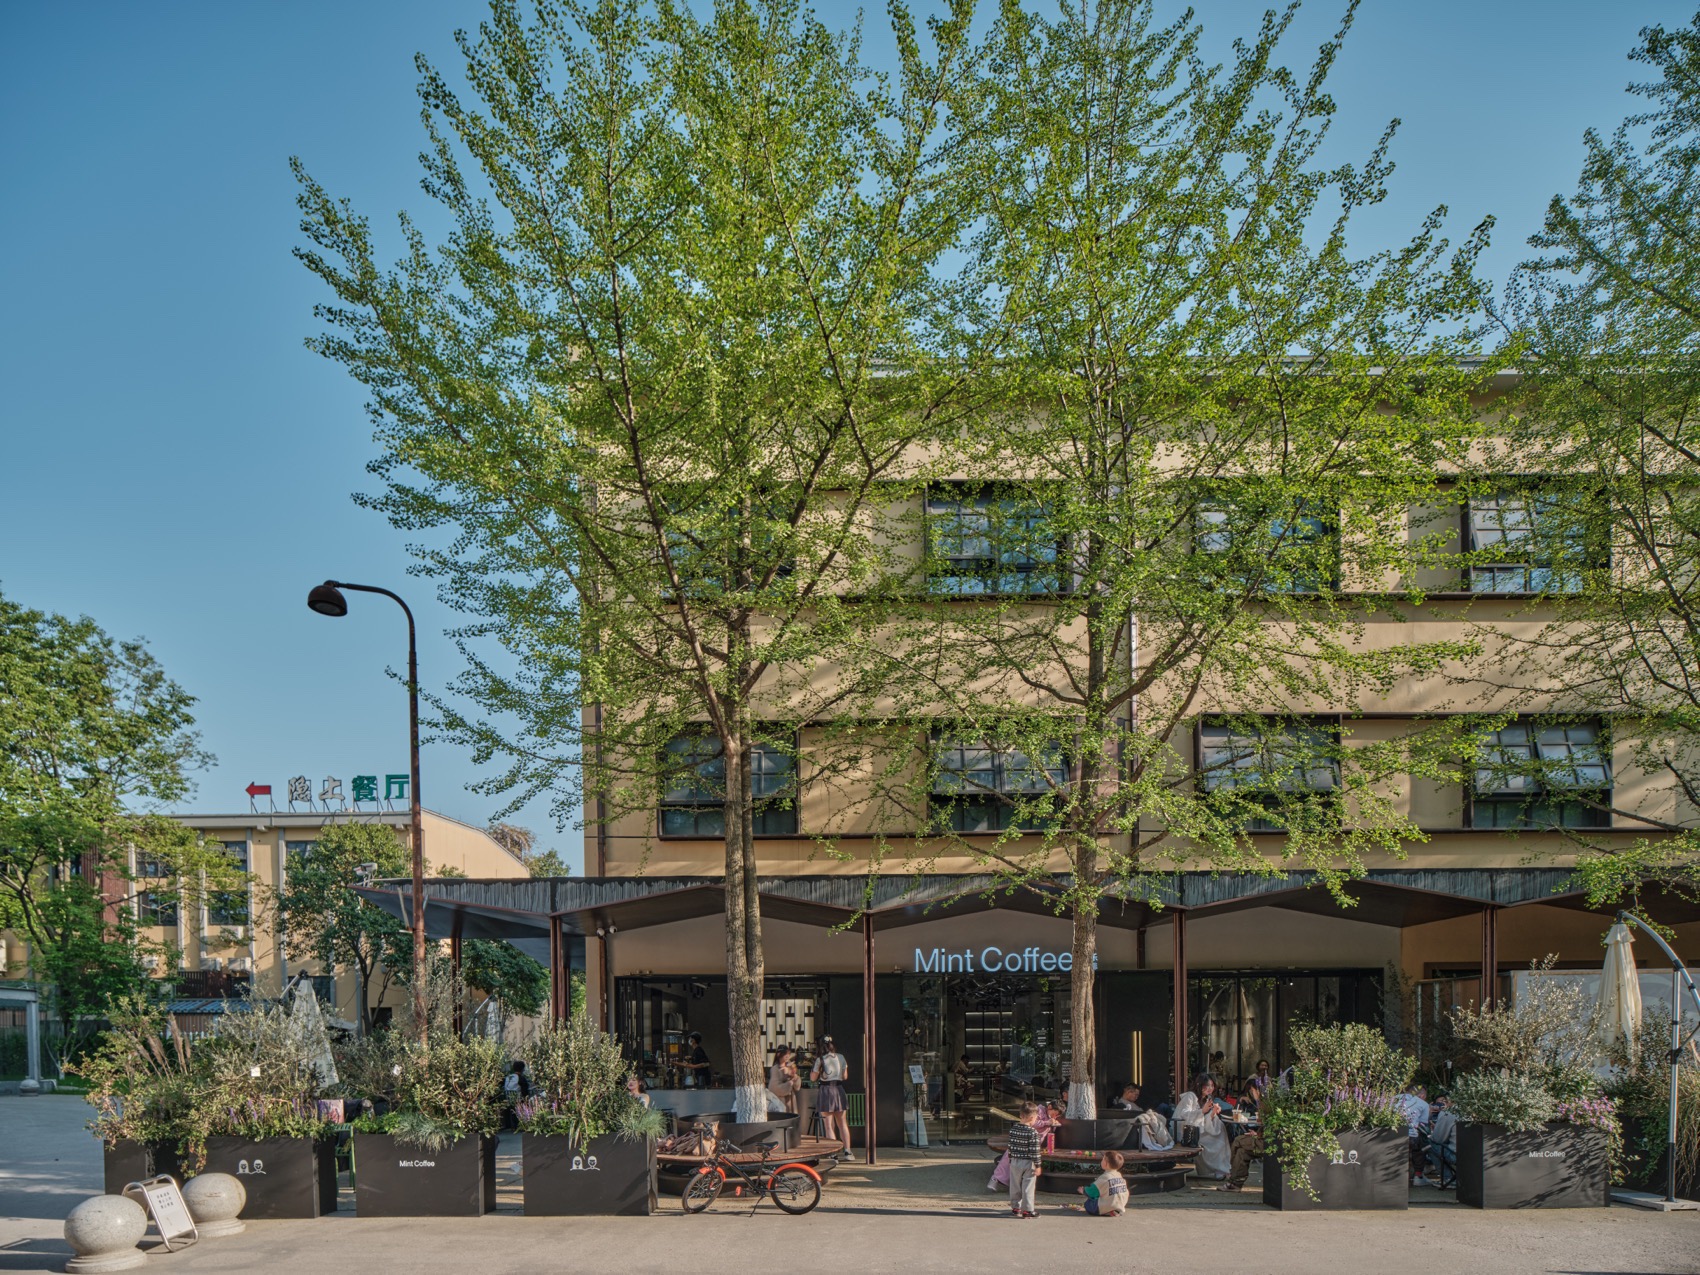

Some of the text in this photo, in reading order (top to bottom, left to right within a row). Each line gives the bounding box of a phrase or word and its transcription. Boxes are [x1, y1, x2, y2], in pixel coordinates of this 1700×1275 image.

[914, 948, 974, 973] Mint
[980, 946, 1073, 973] Coffee
[1544, 1150, 1566, 1158] Coffee
